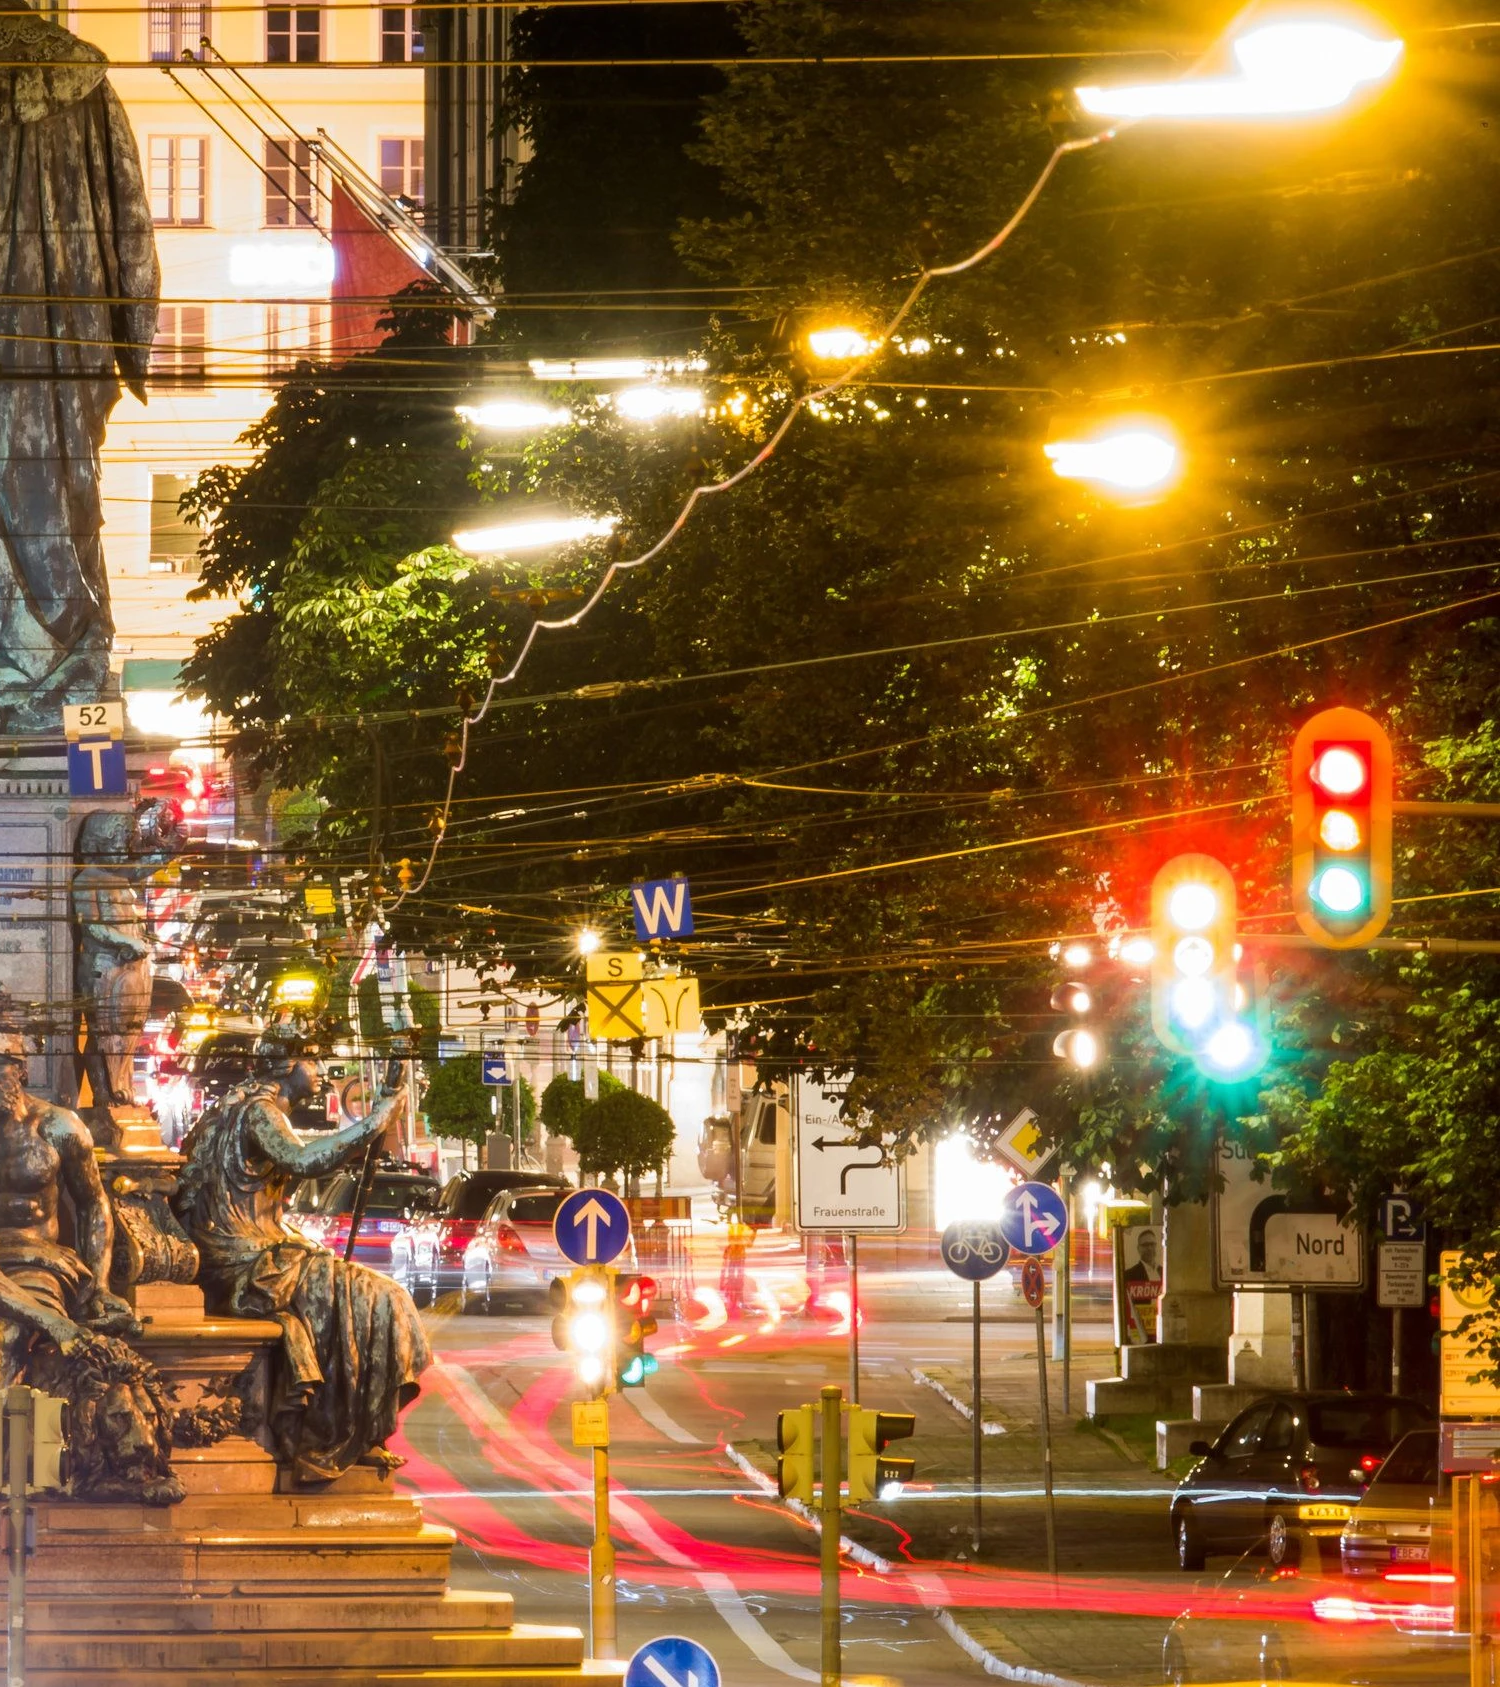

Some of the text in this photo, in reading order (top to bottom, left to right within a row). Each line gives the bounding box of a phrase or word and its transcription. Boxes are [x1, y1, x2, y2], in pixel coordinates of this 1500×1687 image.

[79, 706, 107, 726] 52
[78, 741, 113, 790] T
[632, 883, 686, 935] W
[607, 957, 623, 977] S
[813, 1206, 886, 1218] Frauenstraße
[1386, 1199, 1412, 1237] P
[1296, 1232, 1345, 1256] Nord
[884, 1470, 899, 1478] 522
[1396, 1548, 1413, 1558] EBE
